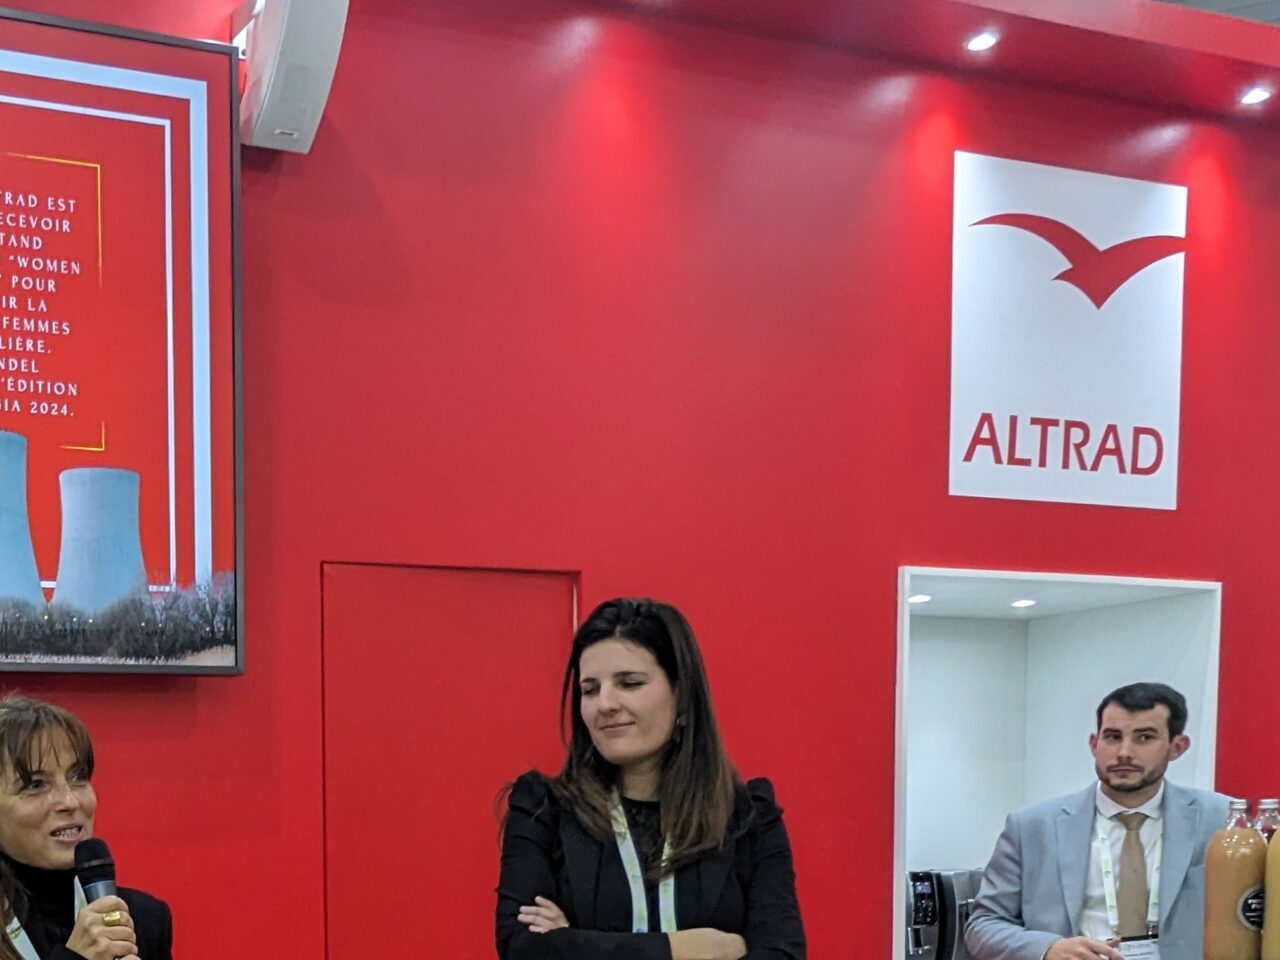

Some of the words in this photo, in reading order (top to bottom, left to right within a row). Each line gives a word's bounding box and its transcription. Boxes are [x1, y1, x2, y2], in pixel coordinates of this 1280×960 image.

[47, 197, 76, 213] EST
[11, 275, 56, 292] POUR
[27, 298, 47, 312] LA
[2, 316, 70, 335] FEMMES
[30, 401, 74, 417] 2024.
[961, 411, 1165, 476] ALTRAD
